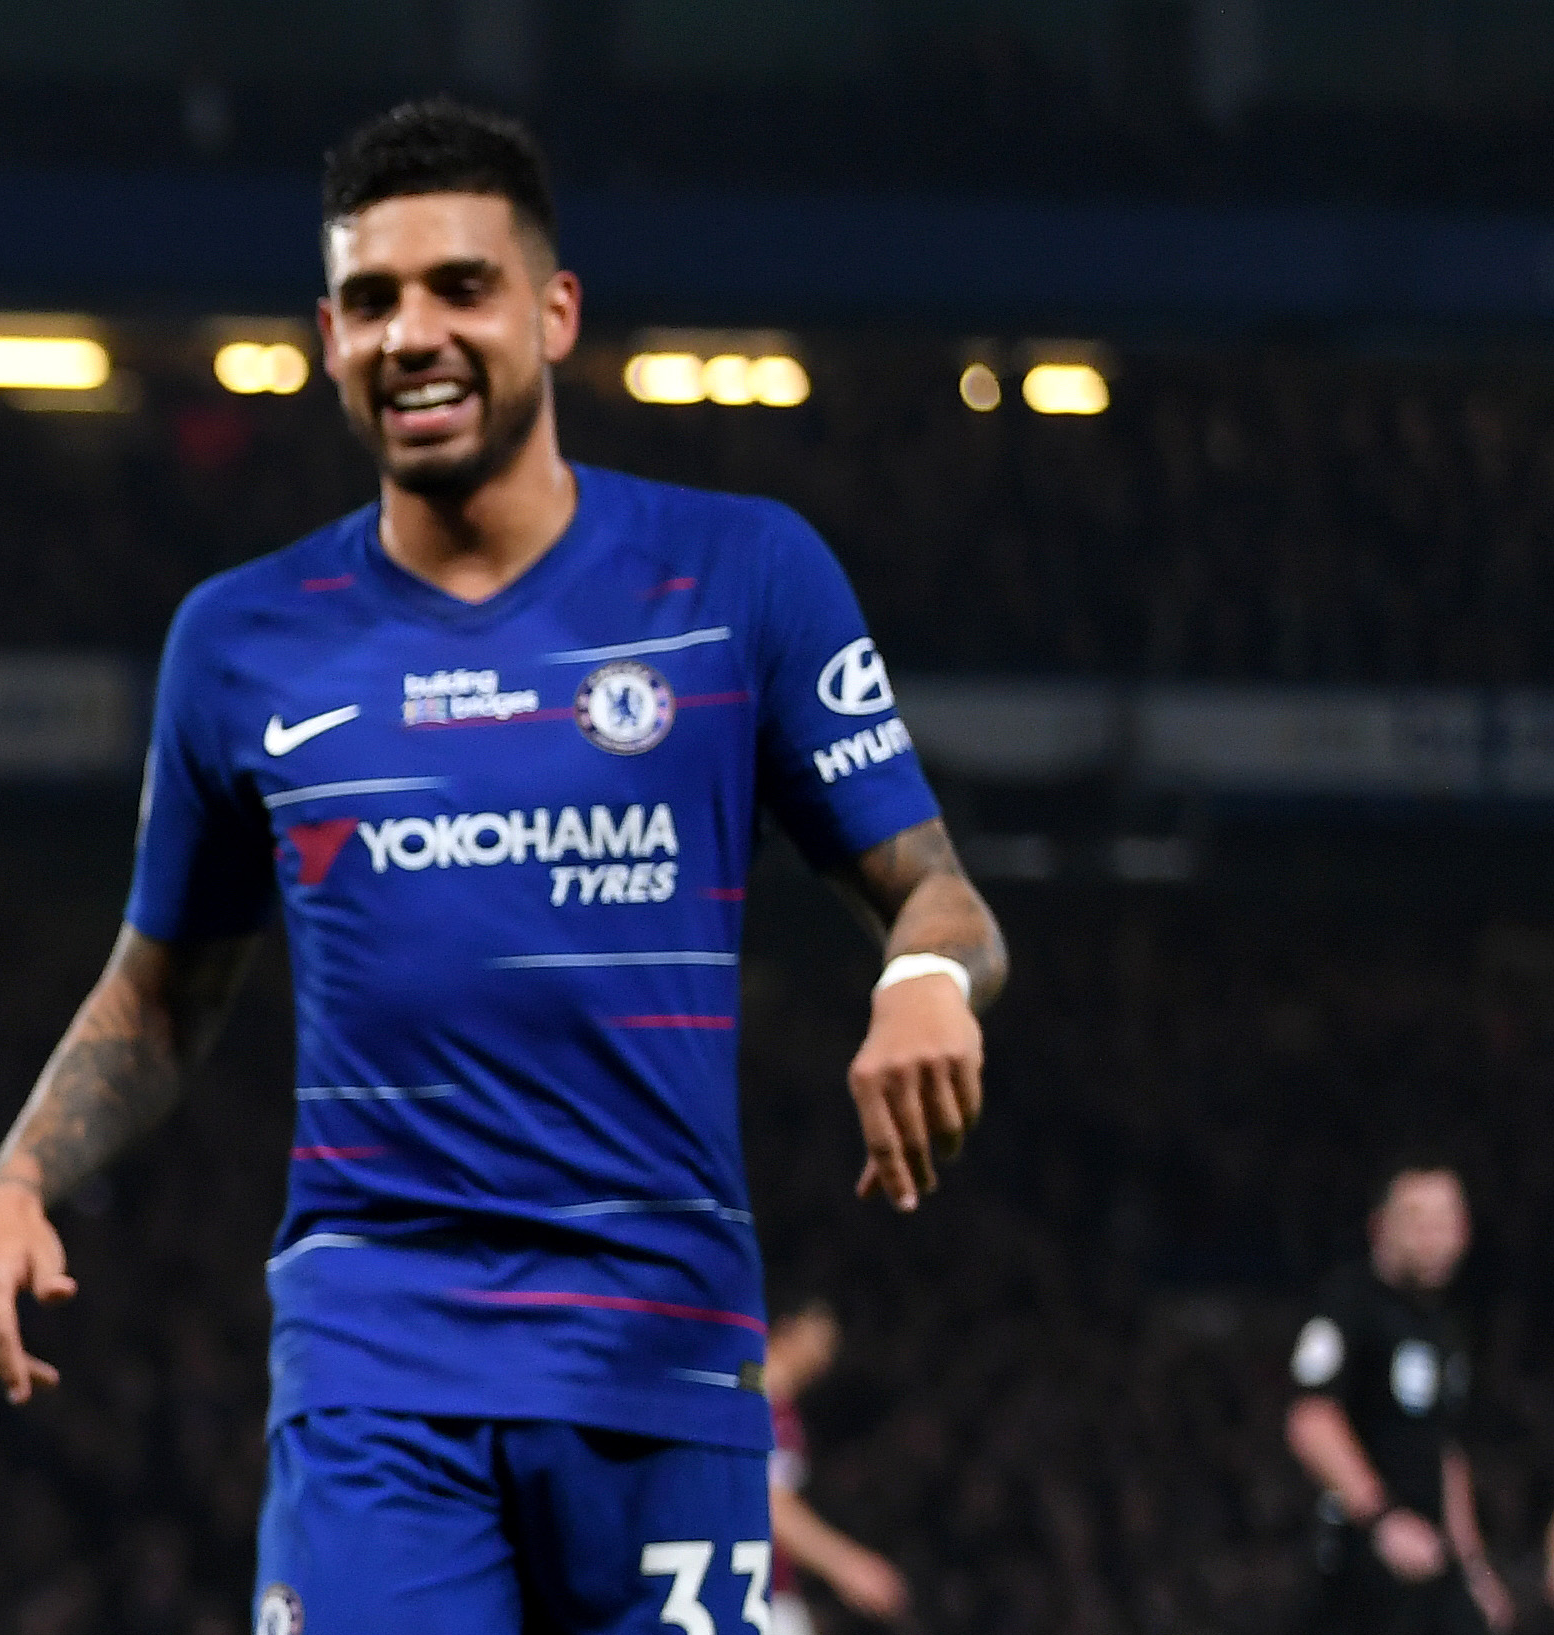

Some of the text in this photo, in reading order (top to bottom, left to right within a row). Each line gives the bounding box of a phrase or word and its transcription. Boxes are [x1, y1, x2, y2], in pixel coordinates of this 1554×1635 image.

[813, 716, 912, 783] HYUN
[357, 803, 678, 873] YOKOHAMA
[551, 861, 677, 907] TYRES
